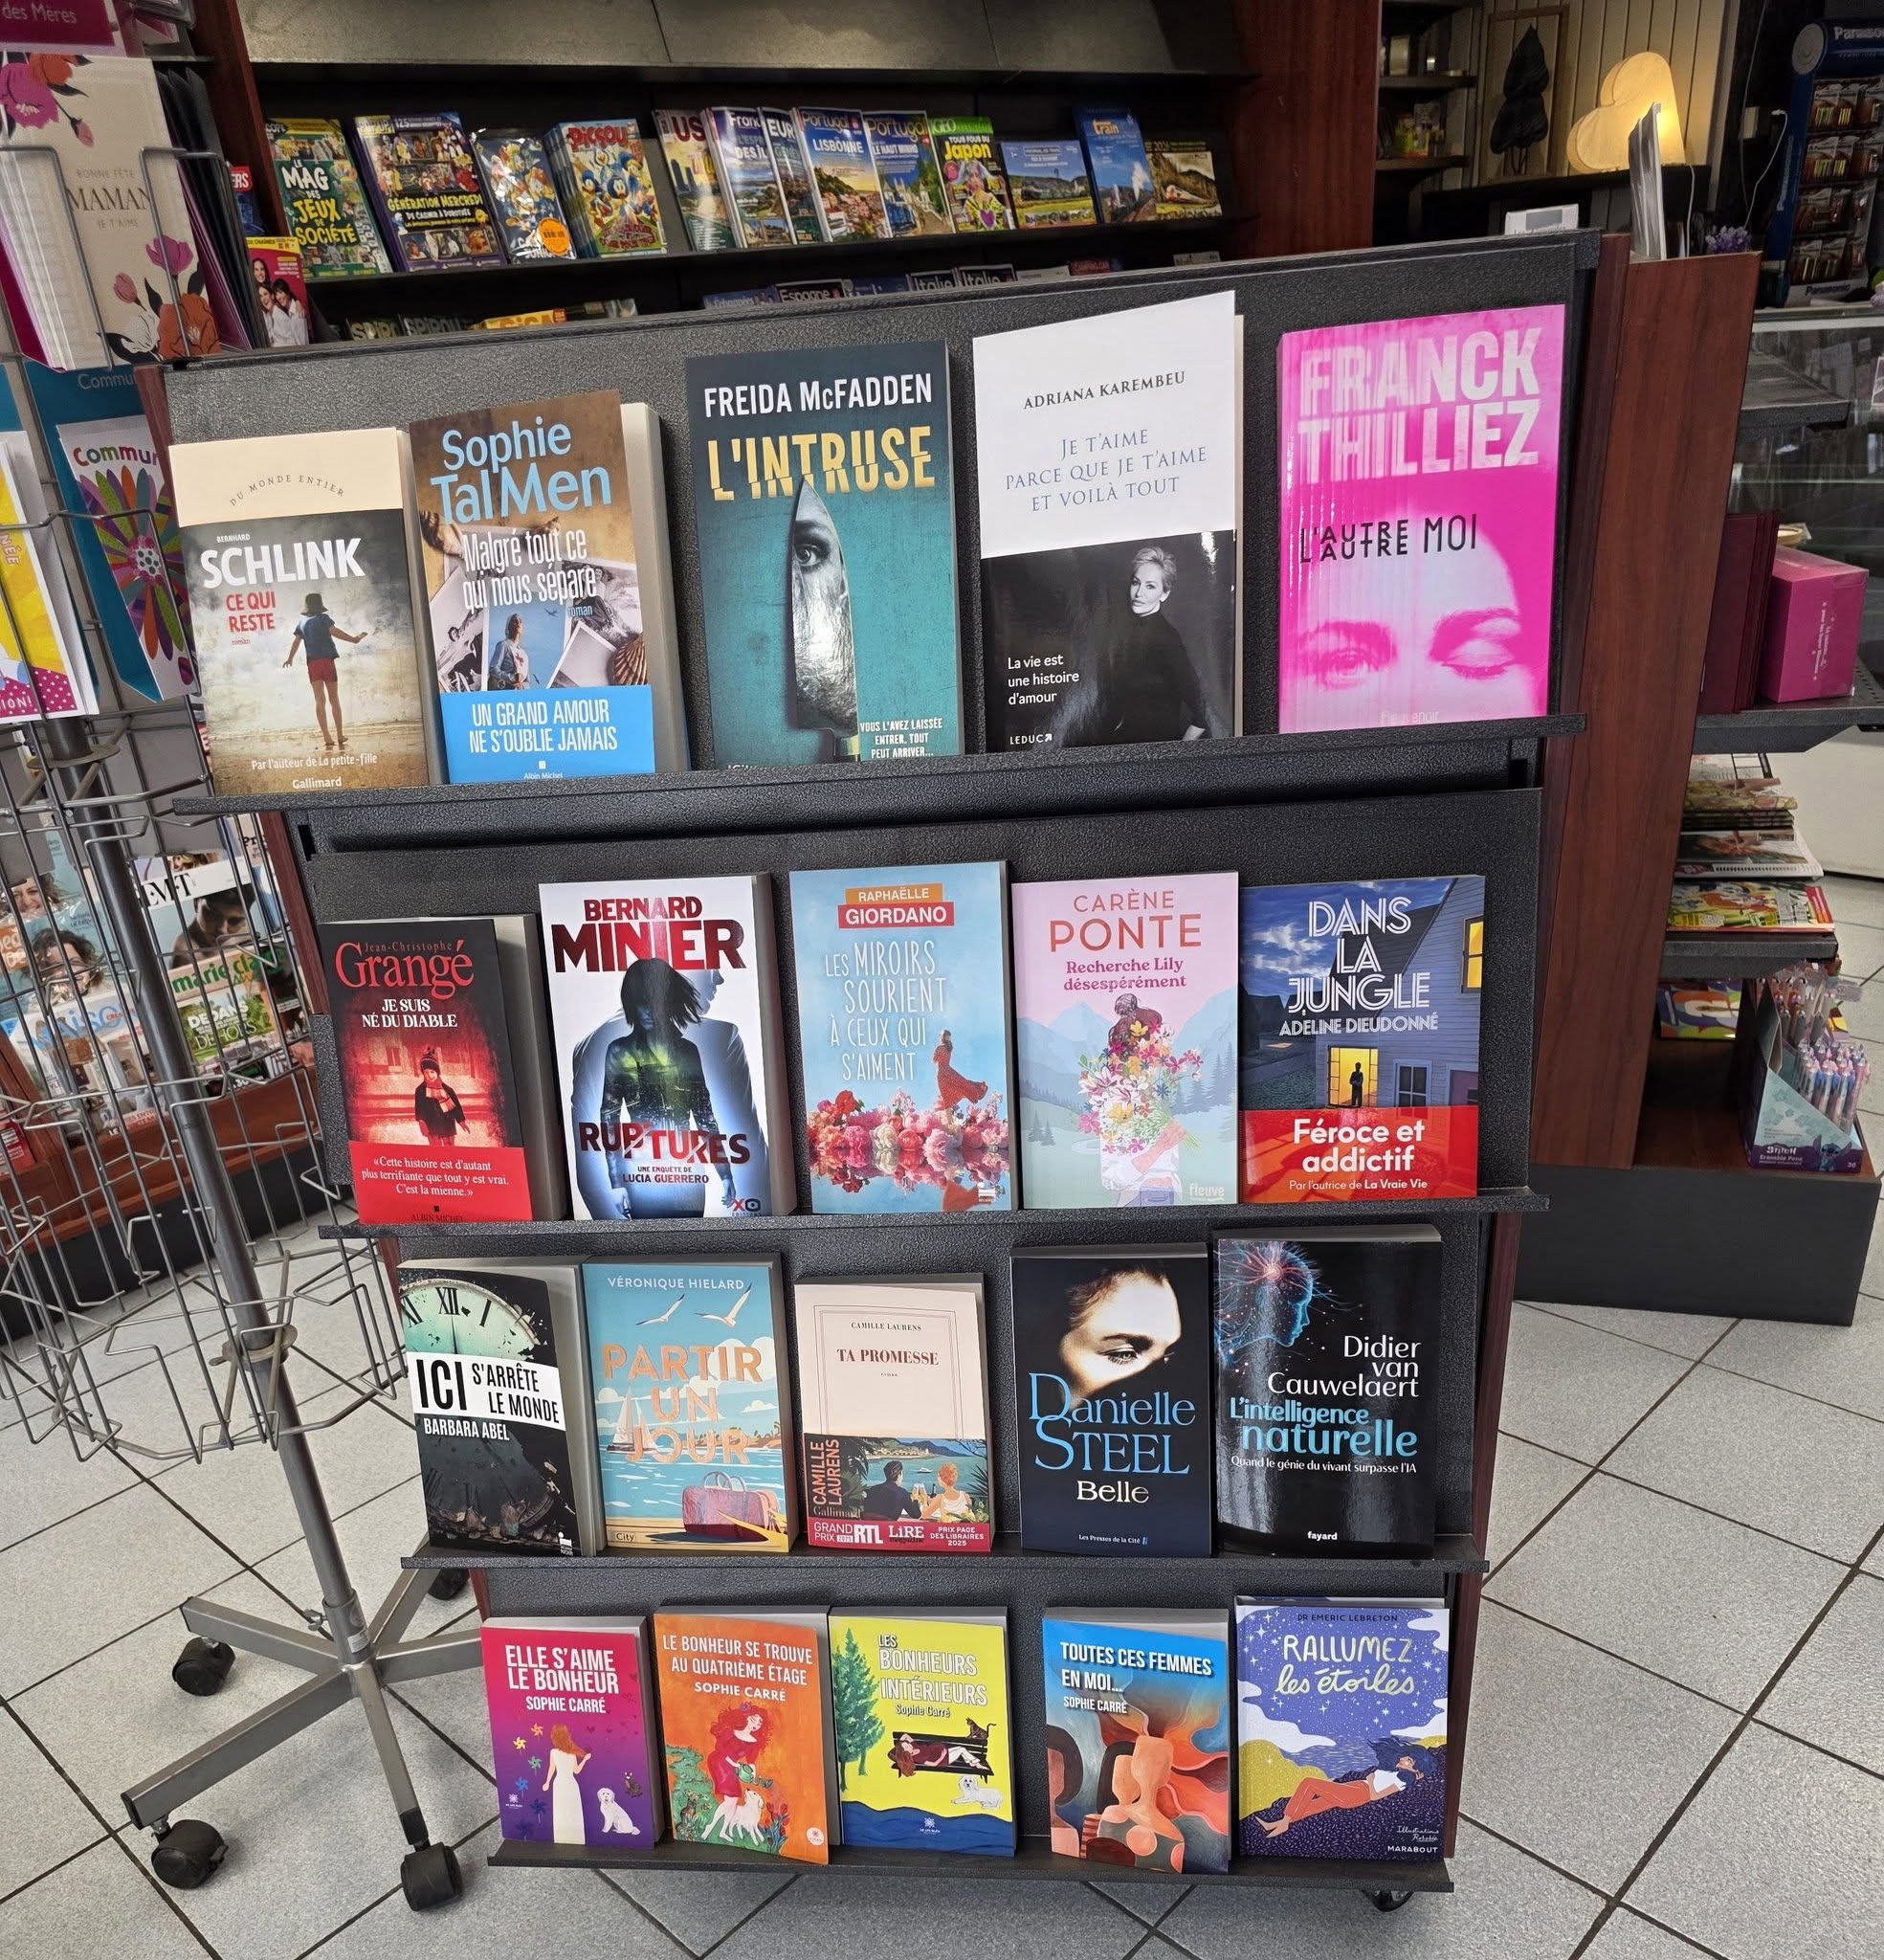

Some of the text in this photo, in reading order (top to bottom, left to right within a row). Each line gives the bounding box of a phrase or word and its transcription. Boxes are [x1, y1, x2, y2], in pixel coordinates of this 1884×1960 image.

[2, 6, 78, 24] des Mères
[1834, 27, 1884, 39] Panaso
[672, 116, 706, 142] US
[803, 112, 849, 132] Portugal
[867, 117, 928, 141] Portugal
[1094, 120, 1119, 135] train
[813, 138, 864, 154] LISBONNE
[873, 145, 880, 155] LE
[881, 145, 898, 155] HAUT
[944, 142, 991, 161] Japon
[77, 169, 136, 180] BONNE FÊTE
[294, 159, 301, 168] LE
[281, 167, 329, 190] MAG
[65, 188, 149, 212] MAMAN
[306, 190, 321, 199] DES
[388, 194, 482, 212] GÉNÉRATION MERCREDI
[293, 198, 341, 223] JEUX
[107, 219, 138, 229] T'AIME
[295, 225, 357, 245] SOCIÉTÉ
[780, 289, 830, 303] Espagne
[77, 373, 135, 390] Commu
[1300, 327, 1541, 415] FRANCK
[704, 372, 932, 418] FREIDA McFADDEN
[1023, 370, 1186, 410] ADRIANA KAREMBEU
[442, 415, 572, 473] Sophie
[1297, 399, 1540, 484] THILLIEZ
[707, 425, 936, 501] L'INTRUSE
[230, 475, 344, 506] DU MONDE ENTIER
[216, 533, 251, 543] BERNHARD
[200, 537, 366, 590] SCHLINK
[226, 591, 276, 612] CE QUI
[228, 613, 276, 633] RESTE
[1008, 653, 1064, 670] La vie est
[1008, 669, 1079, 687] une histoire
[1008, 689, 1057, 705] d'amour
[472, 699, 610, 727] UN GRAND AMOUR
[860, 717, 942, 732] VOUS L'AVEZ LAISSÉE
[469, 726, 617, 753] NE S'OUBLIE JAMAIS
[876, 733, 928, 745] ENTRER. TOUT
[1009, 733, 1045, 746] LEDUC
[872, 746, 933, 758] PEUT ARRIVER...
[292, 776, 343, 789] Gallimard
[858, 886, 930, 902] RAPHAËLLE
[1073, 888, 1174, 913] CARÈNE
[584, 896, 703, 922] BERNARD
[845, 906, 947, 925] GIORDANO
[1050, 914, 1202, 952] PONTE
[365, 941, 453, 954] Jean-Christophe
[551, 920, 746, 972] MINIER
[825, 940, 935, 977] LES MIROIRS
[1066, 957, 1184, 974] Recherche Lily
[172, 963, 229, 993] marie
[335, 940, 475, 1000] Grangé
[1064, 975, 1186, 992] désespérément
[382, 998, 431, 1012] JE SUIS
[844, 977, 947, 1014] SOURIENT
[188, 1002, 249, 1029] DEDANS
[363, 1013, 458, 1028] NÉ DU DIABLE
[1279, 1012, 1439, 1036] ADELINE DIEUDONNÉ
[194, 1020, 256, 1050] DEHORS
[1294, 1118, 1425, 1145] Féroce et
[578, 1122, 751, 1165] RUPTURES
[1301, 1145, 1414, 1173] addictif
[396, 1183, 474, 1196] C'est la mienne.»
[623, 1174, 652, 1183] LUCIA
[1189, 1183, 1225, 1197] fleuve
[608, 1275, 744, 1290] VÉRONIQUE HIELARD
[852, 1322, 885, 1330] CAMILLE
[836, 1348, 940, 1366] TA PROMESSE
[1343, 1334, 1422, 1359] Didier
[601, 1344, 763, 1383] PARTIR
[1371, 1359, 1419, 1378] van
[416, 1359, 467, 1411] ICI
[472, 1362, 540, 1392] S'ARRÊTE
[1268, 1371, 1419, 1398] Cauwelaert
[488, 1391, 560, 1423] LE MONDE
[1029, 1372, 1196, 1426] Danielle
[423, 1417, 510, 1440] BARBARA ABEL
[1034, 1414, 1189, 1475] STEEL
[1076, 1480, 1149, 1503] Belle
[616, 1532, 634, 1543] City
[1128, 1536, 1141, 1545] Cité
[1307, 1531, 1338, 1542] fayard
[663, 1635, 812, 1665] LE BONHEUR SE TROUVE
[1060, 1641, 1212, 1676] TOUTES CES FEMMES
[1283, 1635, 1412, 1662] RALLUMEZ
[879, 1648, 977, 1675] BONHEURS
[880, 1676, 988, 1706] INTÉRIEURS
[526, 1696, 607, 1714] SOPHIE CARRÉ
